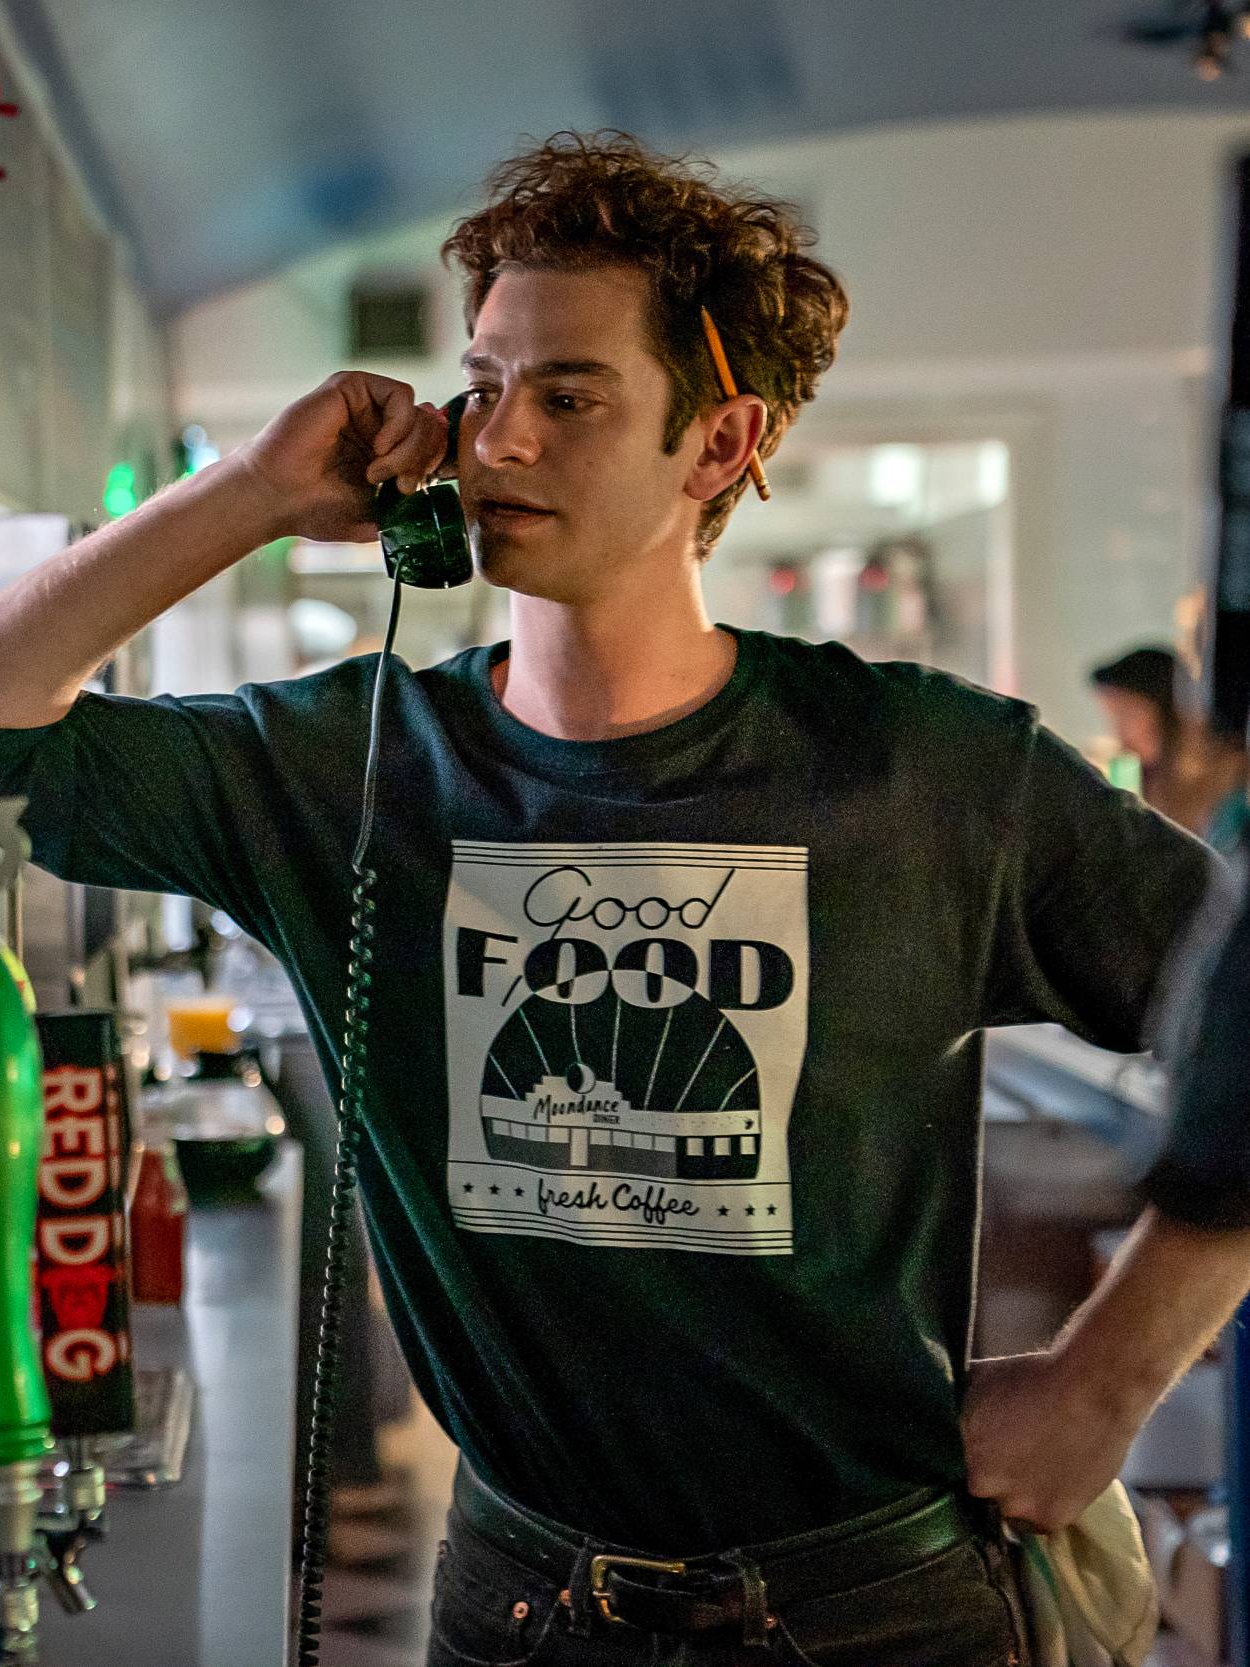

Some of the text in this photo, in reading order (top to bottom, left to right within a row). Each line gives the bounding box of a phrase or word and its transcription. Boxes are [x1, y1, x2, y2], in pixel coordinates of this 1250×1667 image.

[456, 926, 796, 1012] FOOD
[40, 1064, 107, 1208] RED
[533, 1094, 620, 1123] Moondance
[538, 1178, 700, 1225] fresh Coffee
